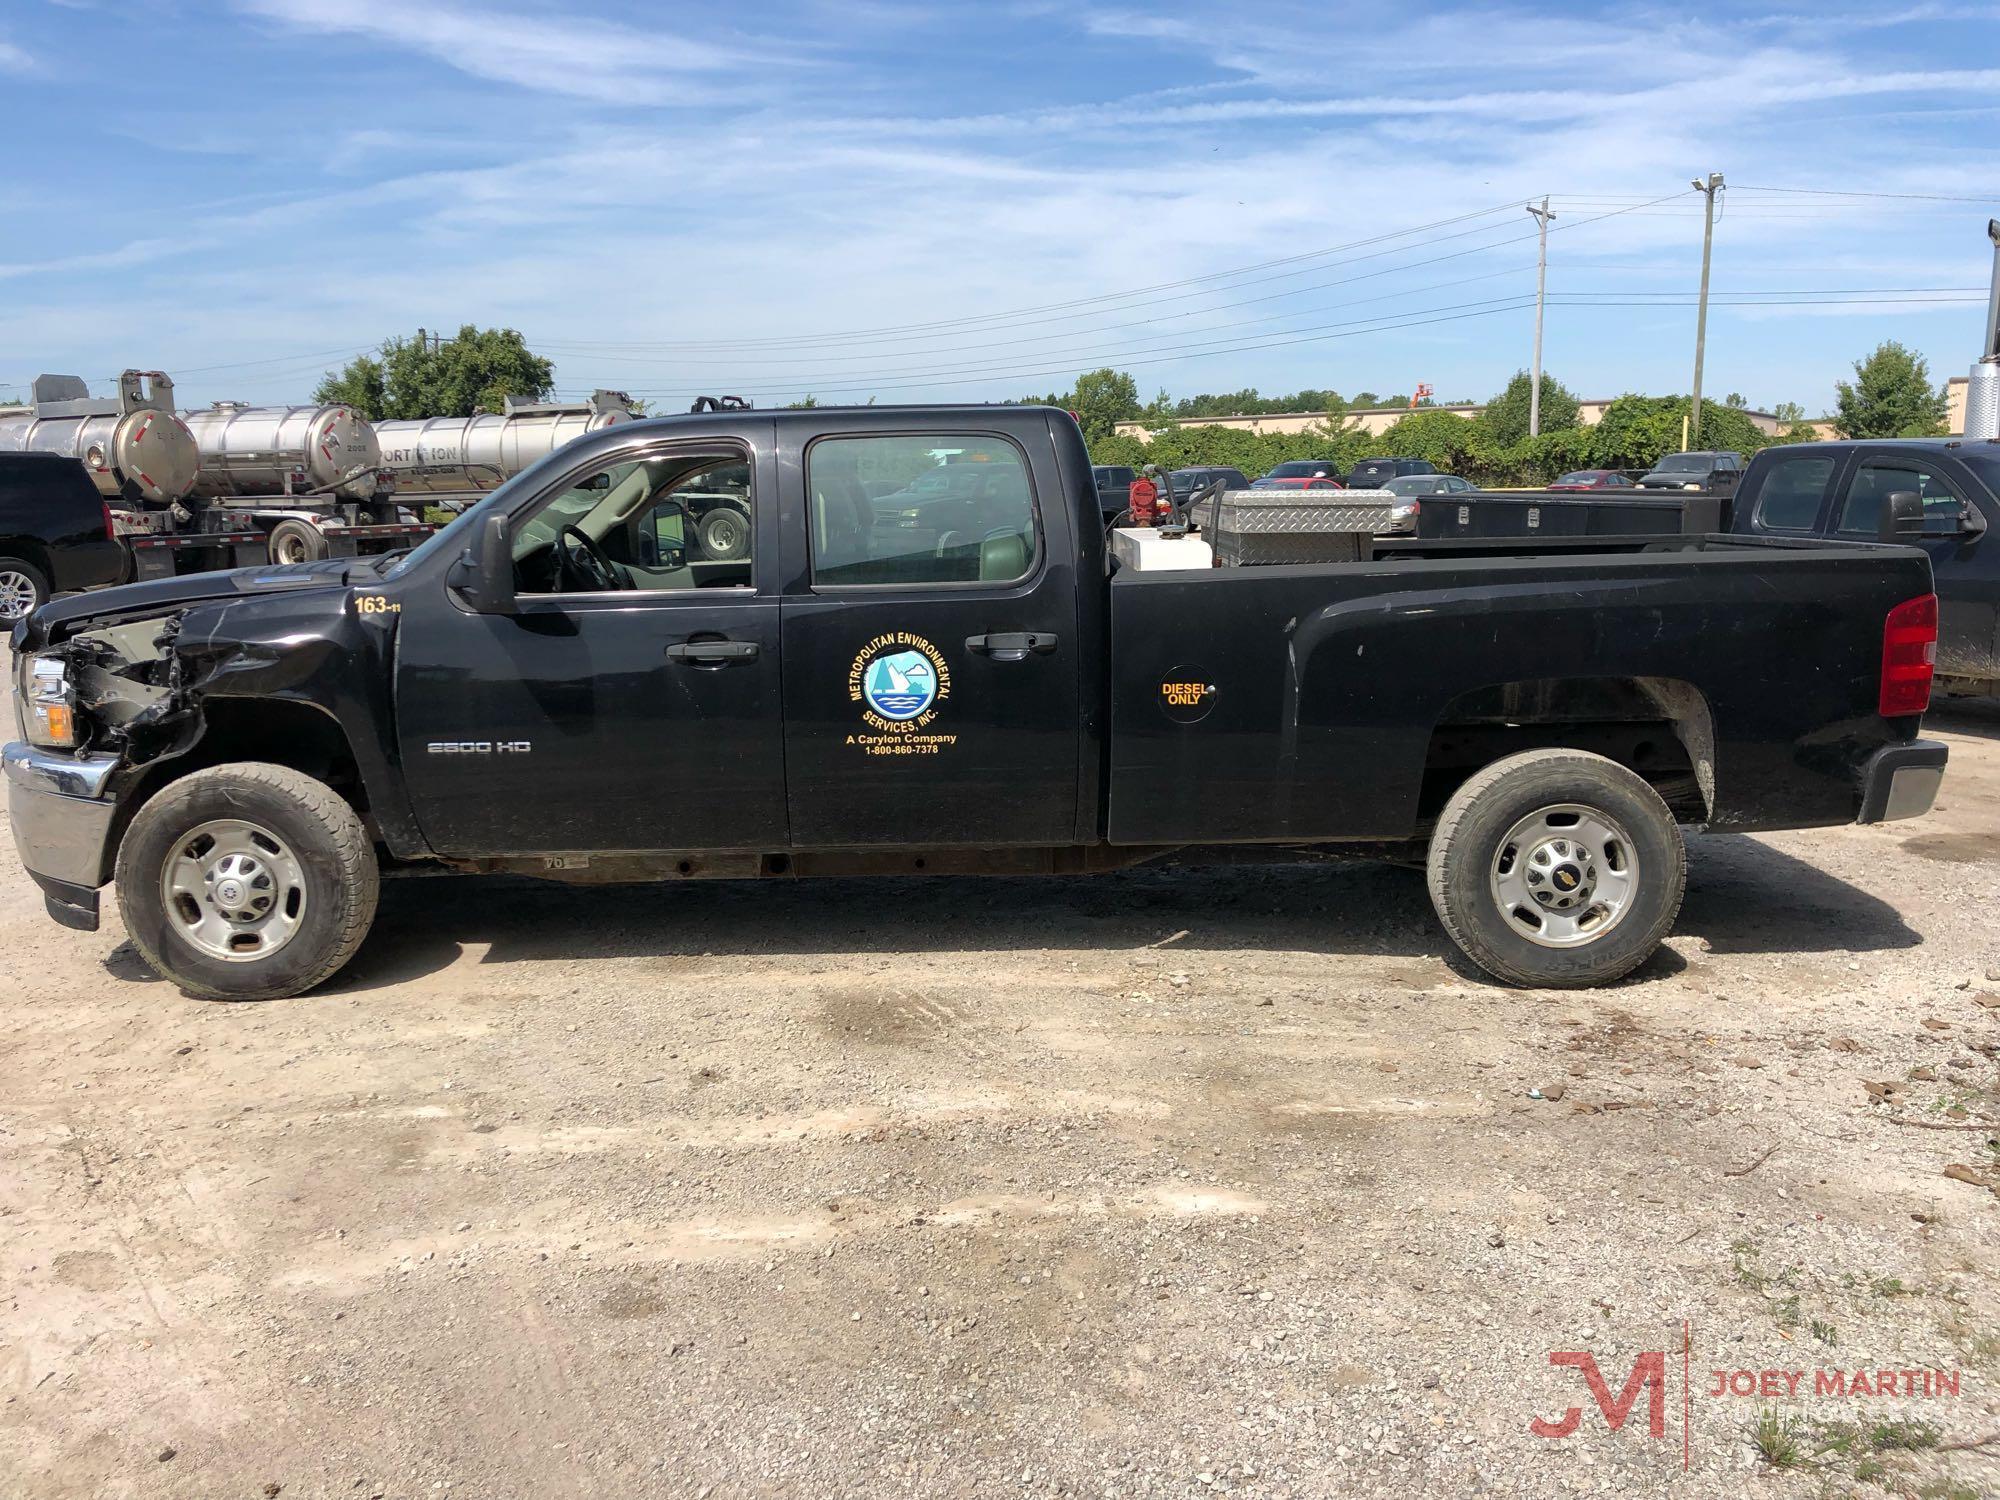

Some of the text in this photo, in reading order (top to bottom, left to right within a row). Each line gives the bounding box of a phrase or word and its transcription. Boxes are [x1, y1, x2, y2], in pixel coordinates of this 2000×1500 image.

[848, 632, 951, 701] METROPOLITAN ENVIRONMENTAL
[1162, 683, 1208, 694] DIESEL
[1168, 694, 1201, 705] ONLY
[846, 734, 957, 745] A Carylon Company
[496, 741, 531, 752] HD
[865, 745, 939, 755] 1-800-860-7378
